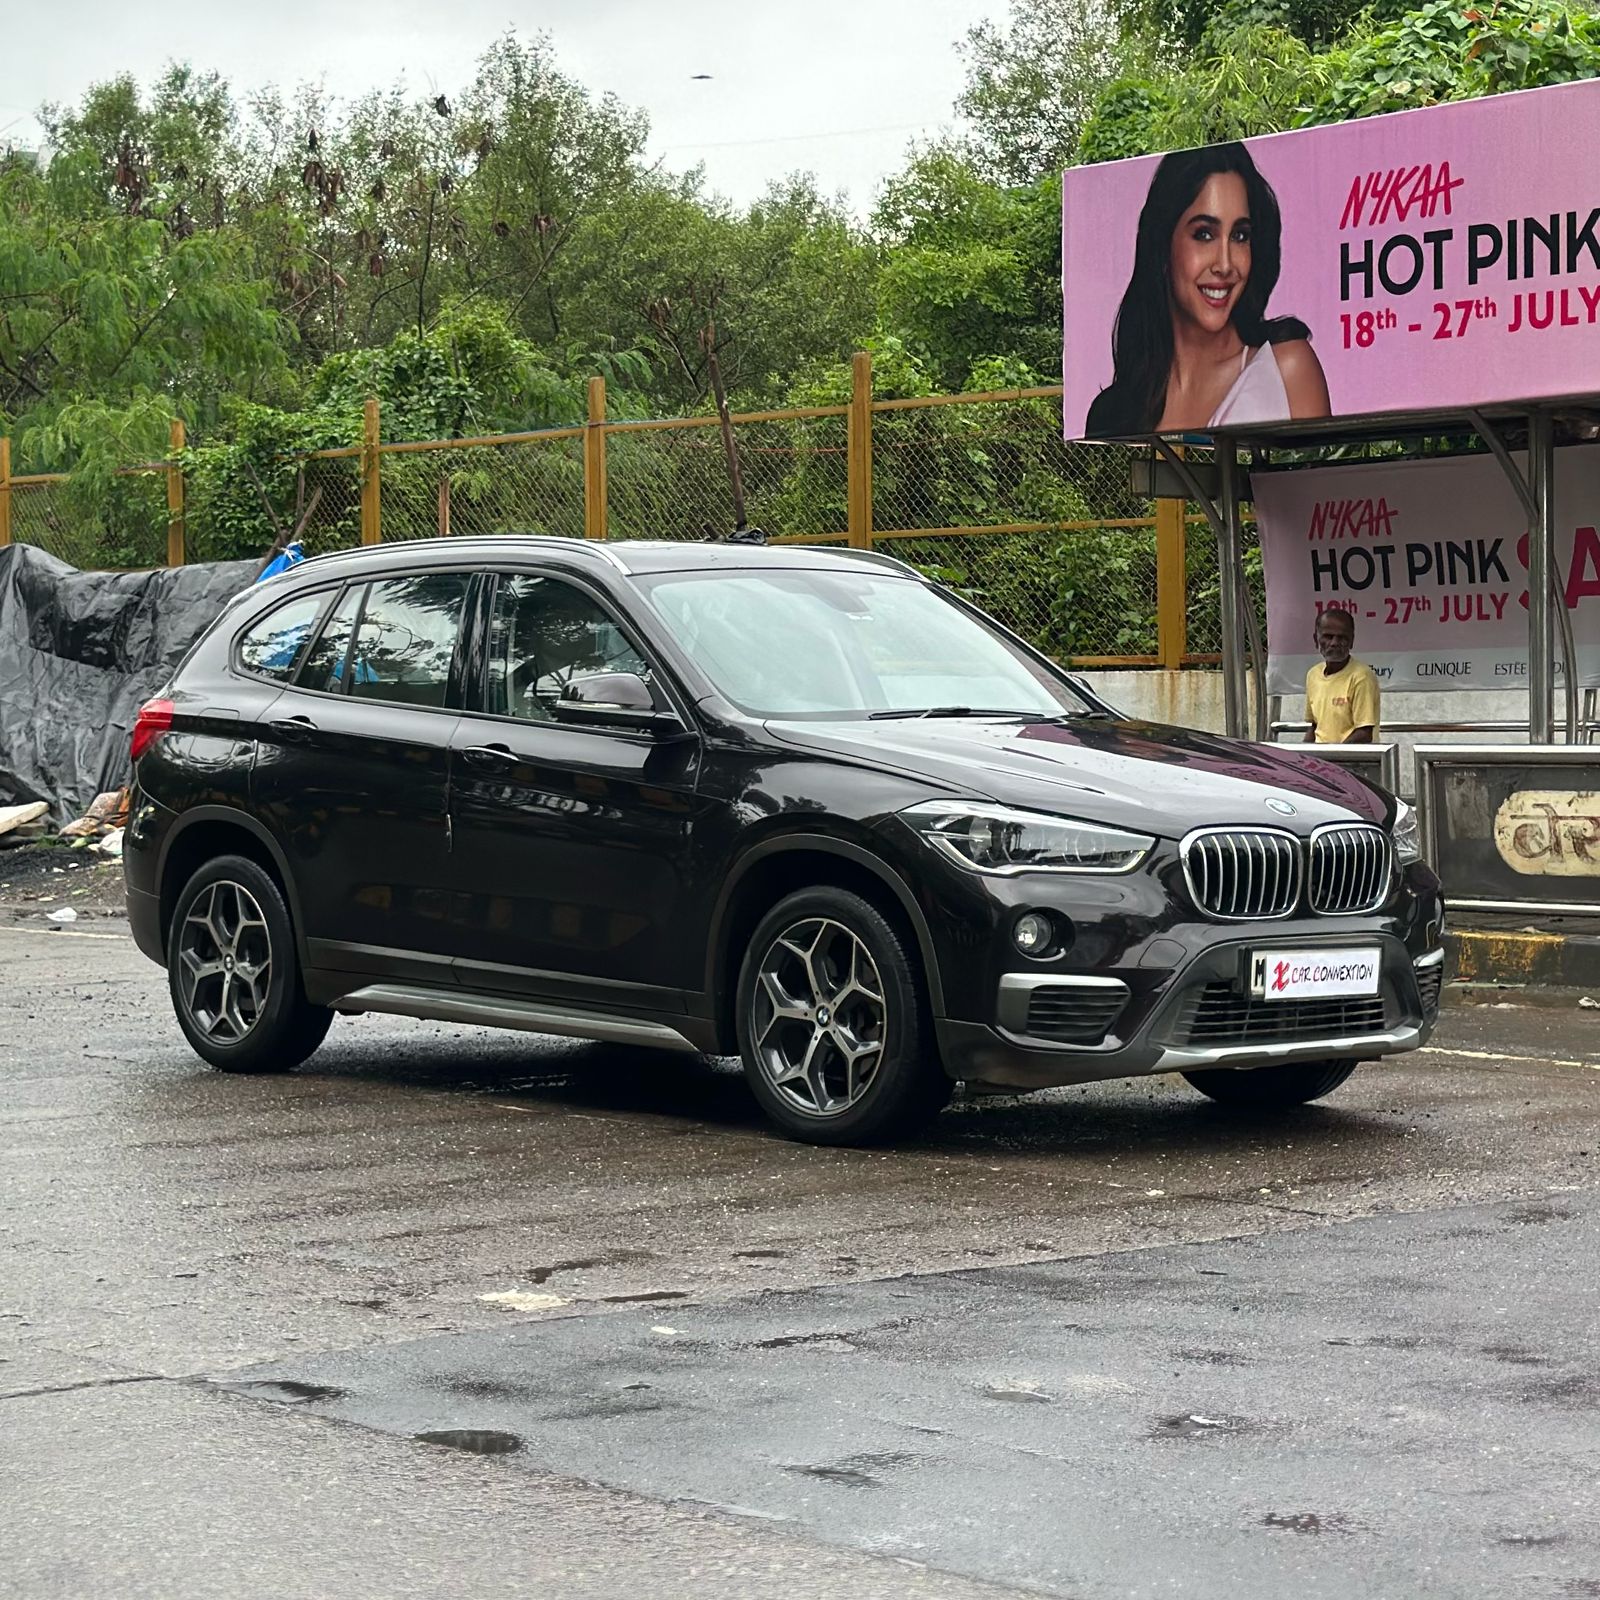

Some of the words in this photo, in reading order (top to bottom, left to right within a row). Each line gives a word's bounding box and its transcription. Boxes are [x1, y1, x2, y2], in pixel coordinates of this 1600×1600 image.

[1339, 161, 1465, 230] NYKAA
[1340, 229, 1453, 301] HOT
[1468, 207, 1600, 285] PINK
[1340, 308, 1397, 350] 18th
[1408, 323, 1422, 332] -
[1433, 297, 1497, 340] 27th
[1508, 285, 1600, 333] JULY
[1308, 497, 1398, 541] NYKAA
[1311, 545, 1396, 592] HOT
[1405, 538, 1510, 587] PINK
[1384, 595, 1431, 625] 27th
[1439, 593, 1509, 623] JULY
[1416, 661, 1472, 677] CLINIQUE
[1291, 966, 1311, 984] CAR
